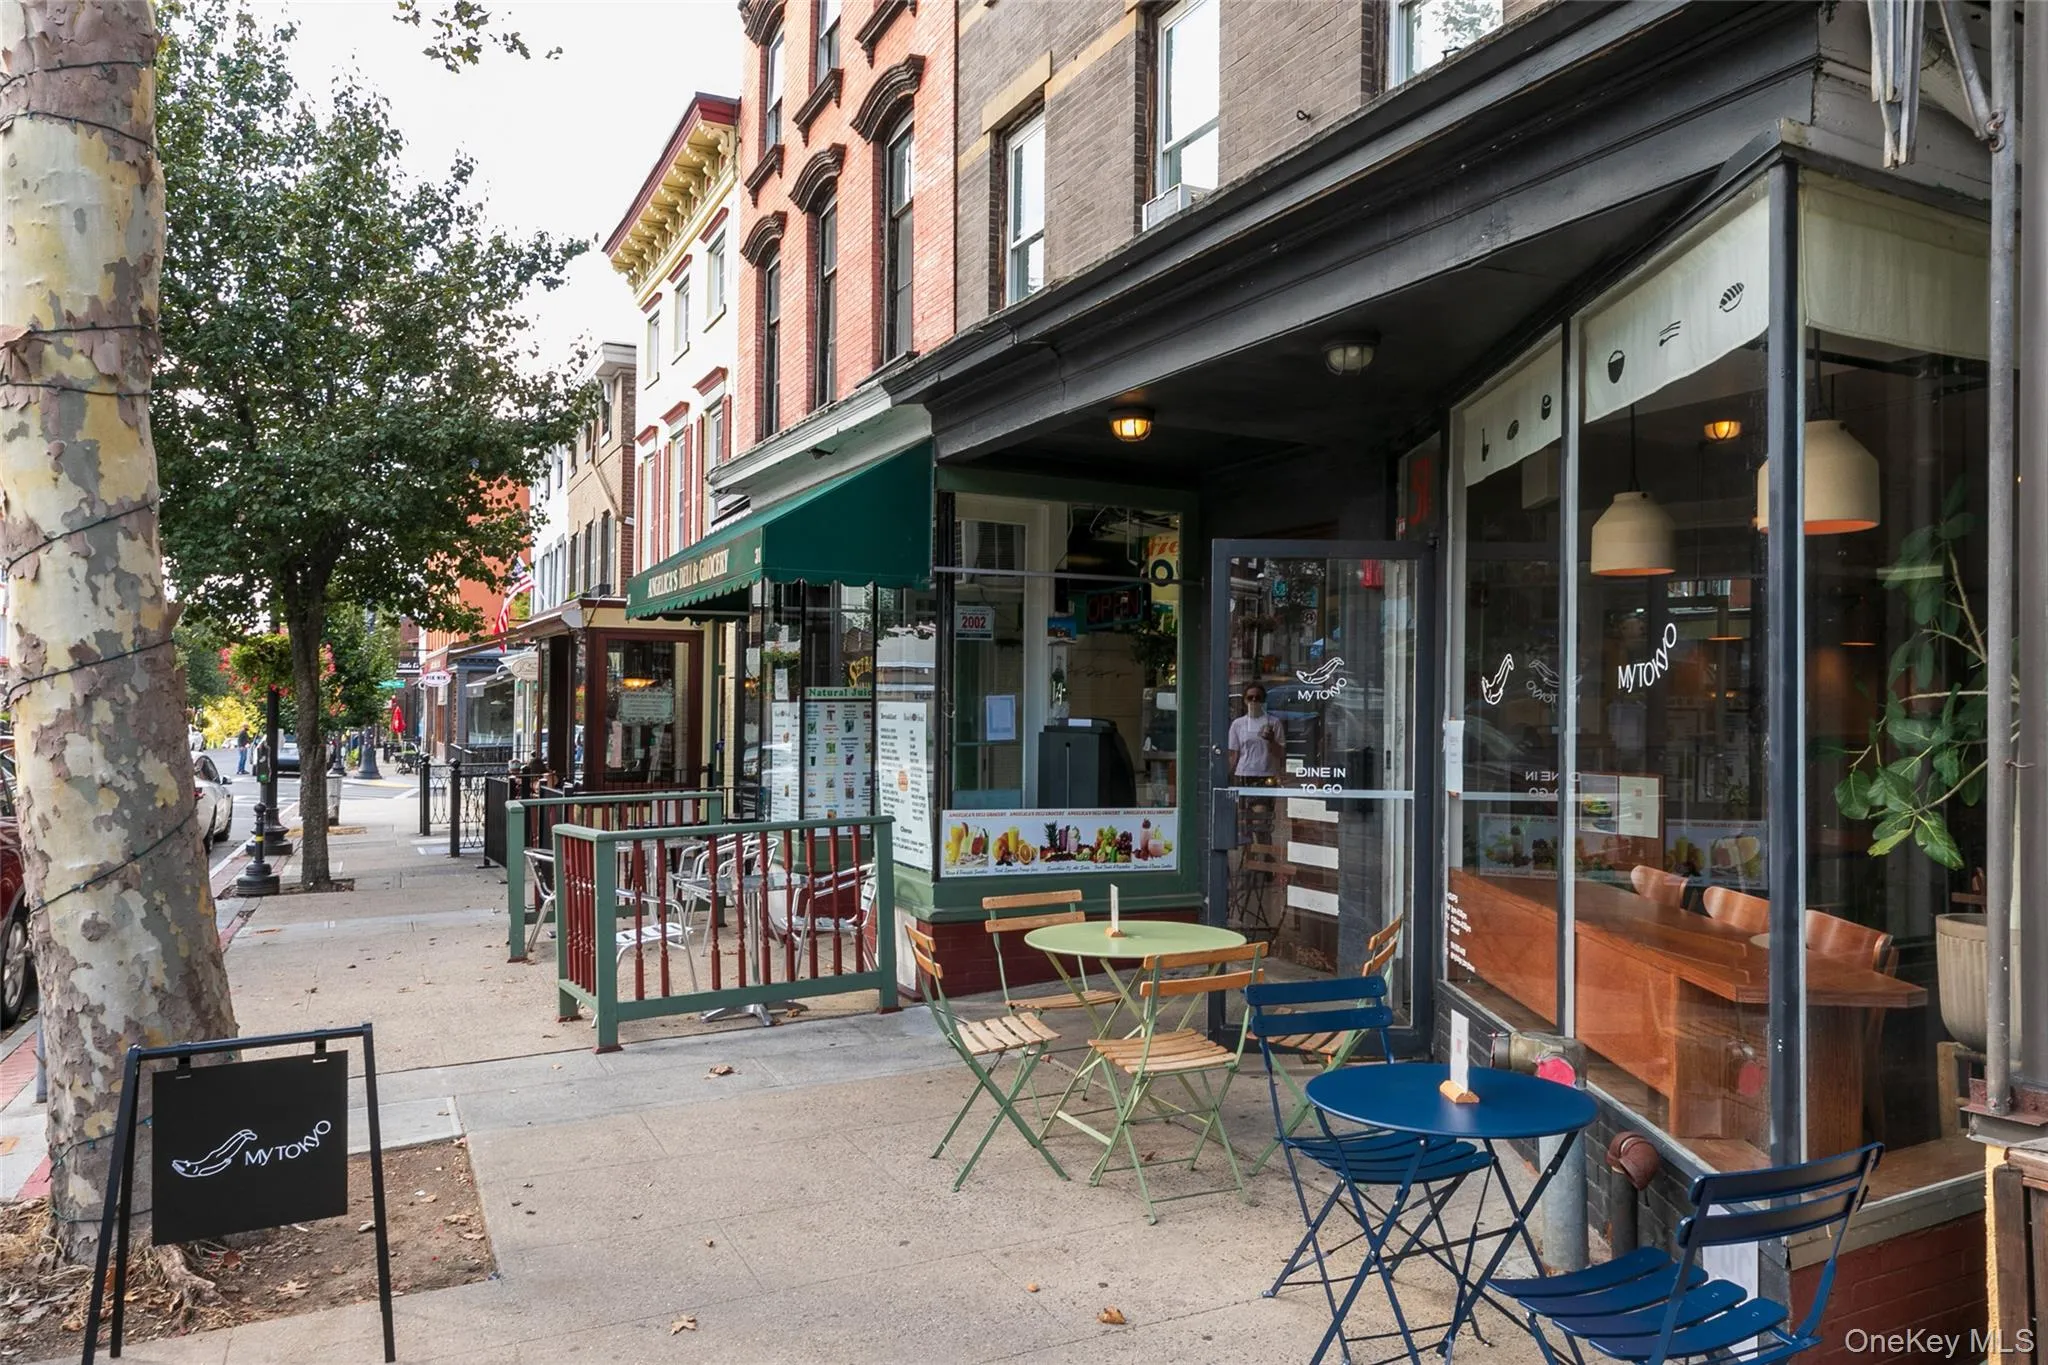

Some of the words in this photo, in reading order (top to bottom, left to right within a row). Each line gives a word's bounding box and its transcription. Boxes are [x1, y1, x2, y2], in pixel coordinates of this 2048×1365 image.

[647, 569, 678, 599] ANGELICA'S
[679, 563, 692, 589] DELI
[700, 548, 730, 582] GROCERY
[962, 616, 987, 629] 2002
[1637, 623, 1677, 687] TOKYO
[809, 688, 847, 697] Natural
[1316, 678, 1347, 700] TOKYO
[1296, 767, 1331, 778] DINE
[1334, 767, 1346, 778] IN
[275, 1120, 332, 1161] TOKYO
